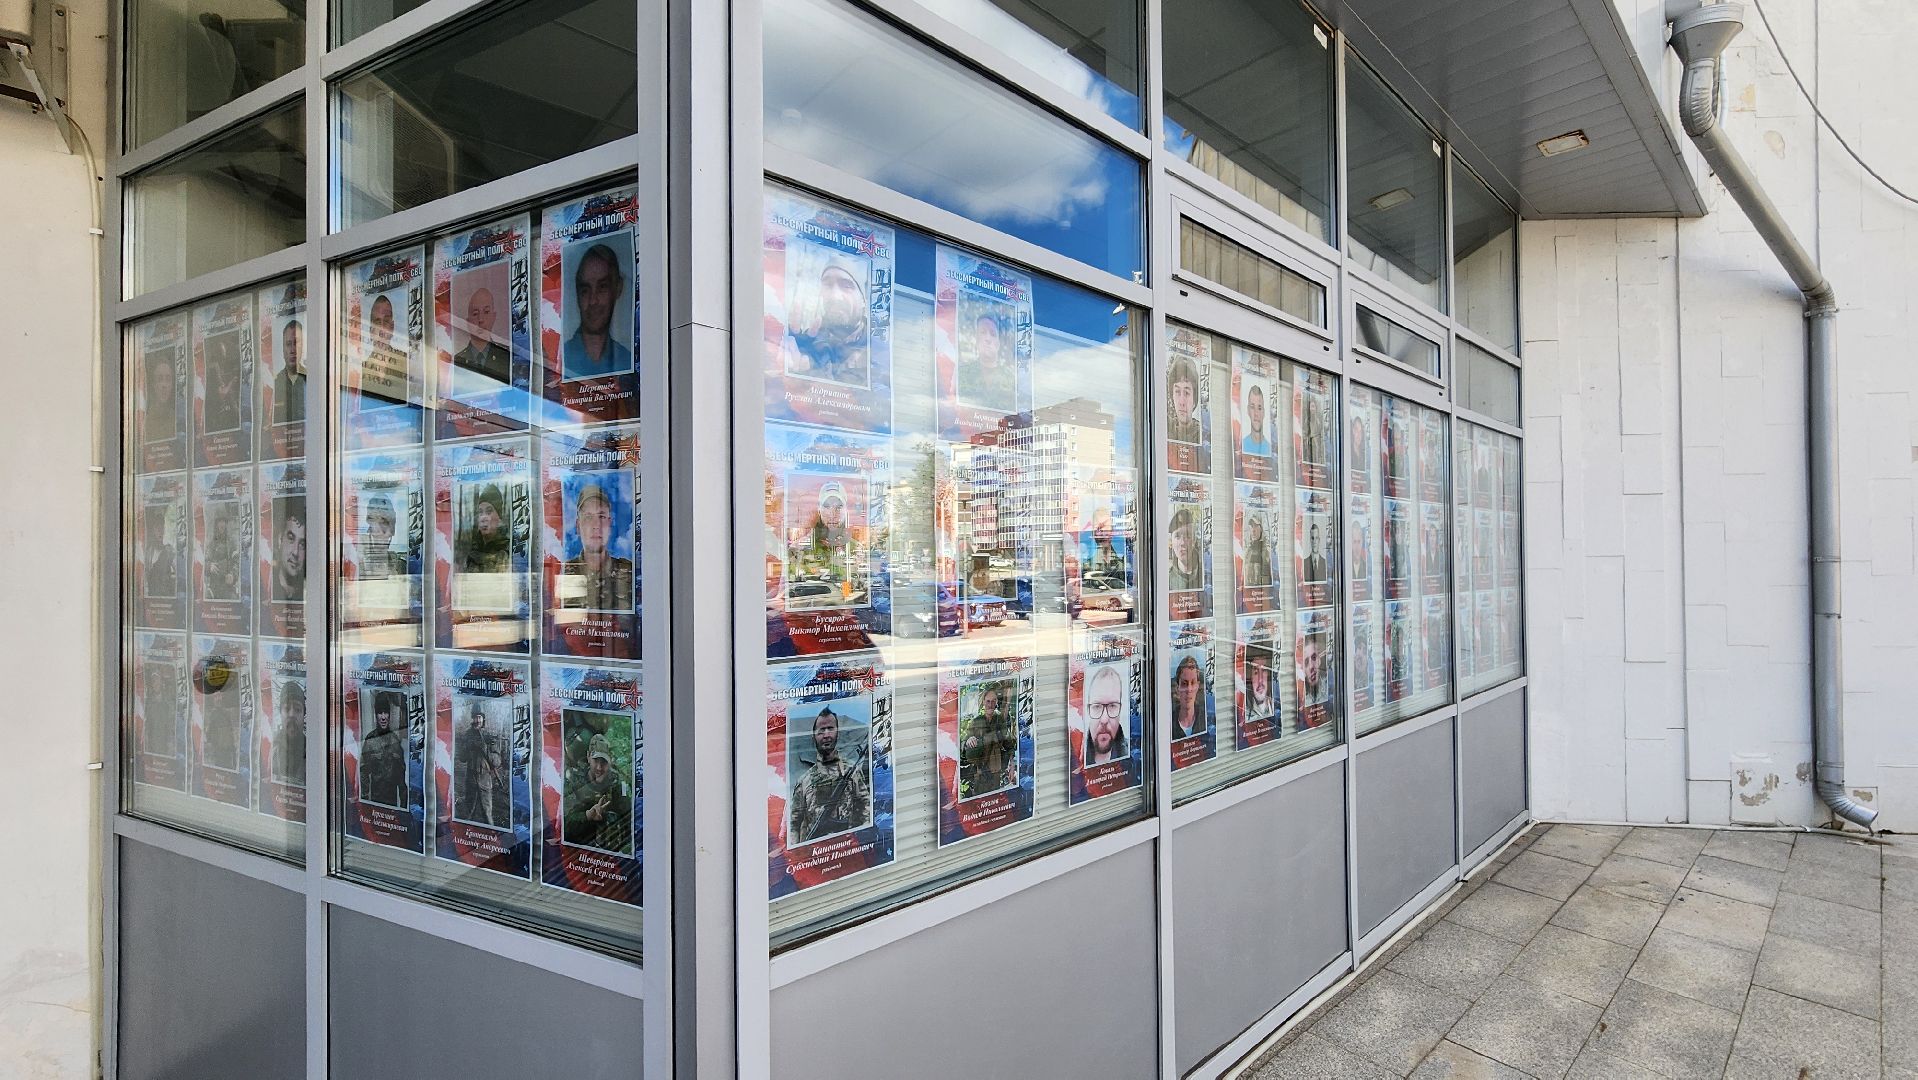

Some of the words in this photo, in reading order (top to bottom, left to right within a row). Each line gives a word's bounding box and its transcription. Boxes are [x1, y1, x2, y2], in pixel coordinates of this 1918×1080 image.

[550, 216, 603, 241] БЕССМЕРТНЫЙ
[605, 210, 626, 228] ПОЛК
[771, 215, 839, 242] БЕССМЕРТНЫЙ
[841, 235, 865, 252] ПОЛК
[442, 249, 486, 270] БЕССМЕРТНЫЙ
[488, 245, 505, 258] ПОЛК
[946, 269, 994, 290] БЕССМЕРТНЫЙ
[995, 284, 1012, 299] ПОЛК
[562, 394, 594, 407] Дмитрий
[594, 390, 633, 404] Валерьевич
[785, 390, 814, 404] Руслан
[815, 396, 871, 413] Александрович
[550, 450, 605, 467] БЕССМЕРТНЫЙ
[606, 449, 627, 464] ПОЛК
[771, 448, 837, 465] БЕССМЕРТНЫЙ
[839, 455, 862, 469] ПОЛК
[441, 462, 487, 479] БЕССМЕРТНЫЙ
[487, 459, 505, 474] ПОЛК
[788, 624, 821, 637] Виктор
[822, 622, 870, 636] Михайлович
[815, 614, 846, 627] Бусаров
[565, 626, 587, 638] Семён
[586, 627, 632, 640] Михайлович
[350, 670, 388, 682] БЕССМЕРТНЫЙ
[388, 671, 405, 685] ПОЛК
[442, 677, 488, 693] БЕССМЕРТНЫЙ
[488, 680, 506, 695] ПОЛК
[550, 685, 605, 704] БЕССМЕРТНЫЙ
[606, 689, 626, 706] ПОЛК
[772, 679, 839, 702] БЕССМЕРТНЫЙ
[841, 677, 865, 692] ПОЛК
[566, 860, 593, 876] Алексей
[594, 867, 629, 883] Сергеевич
